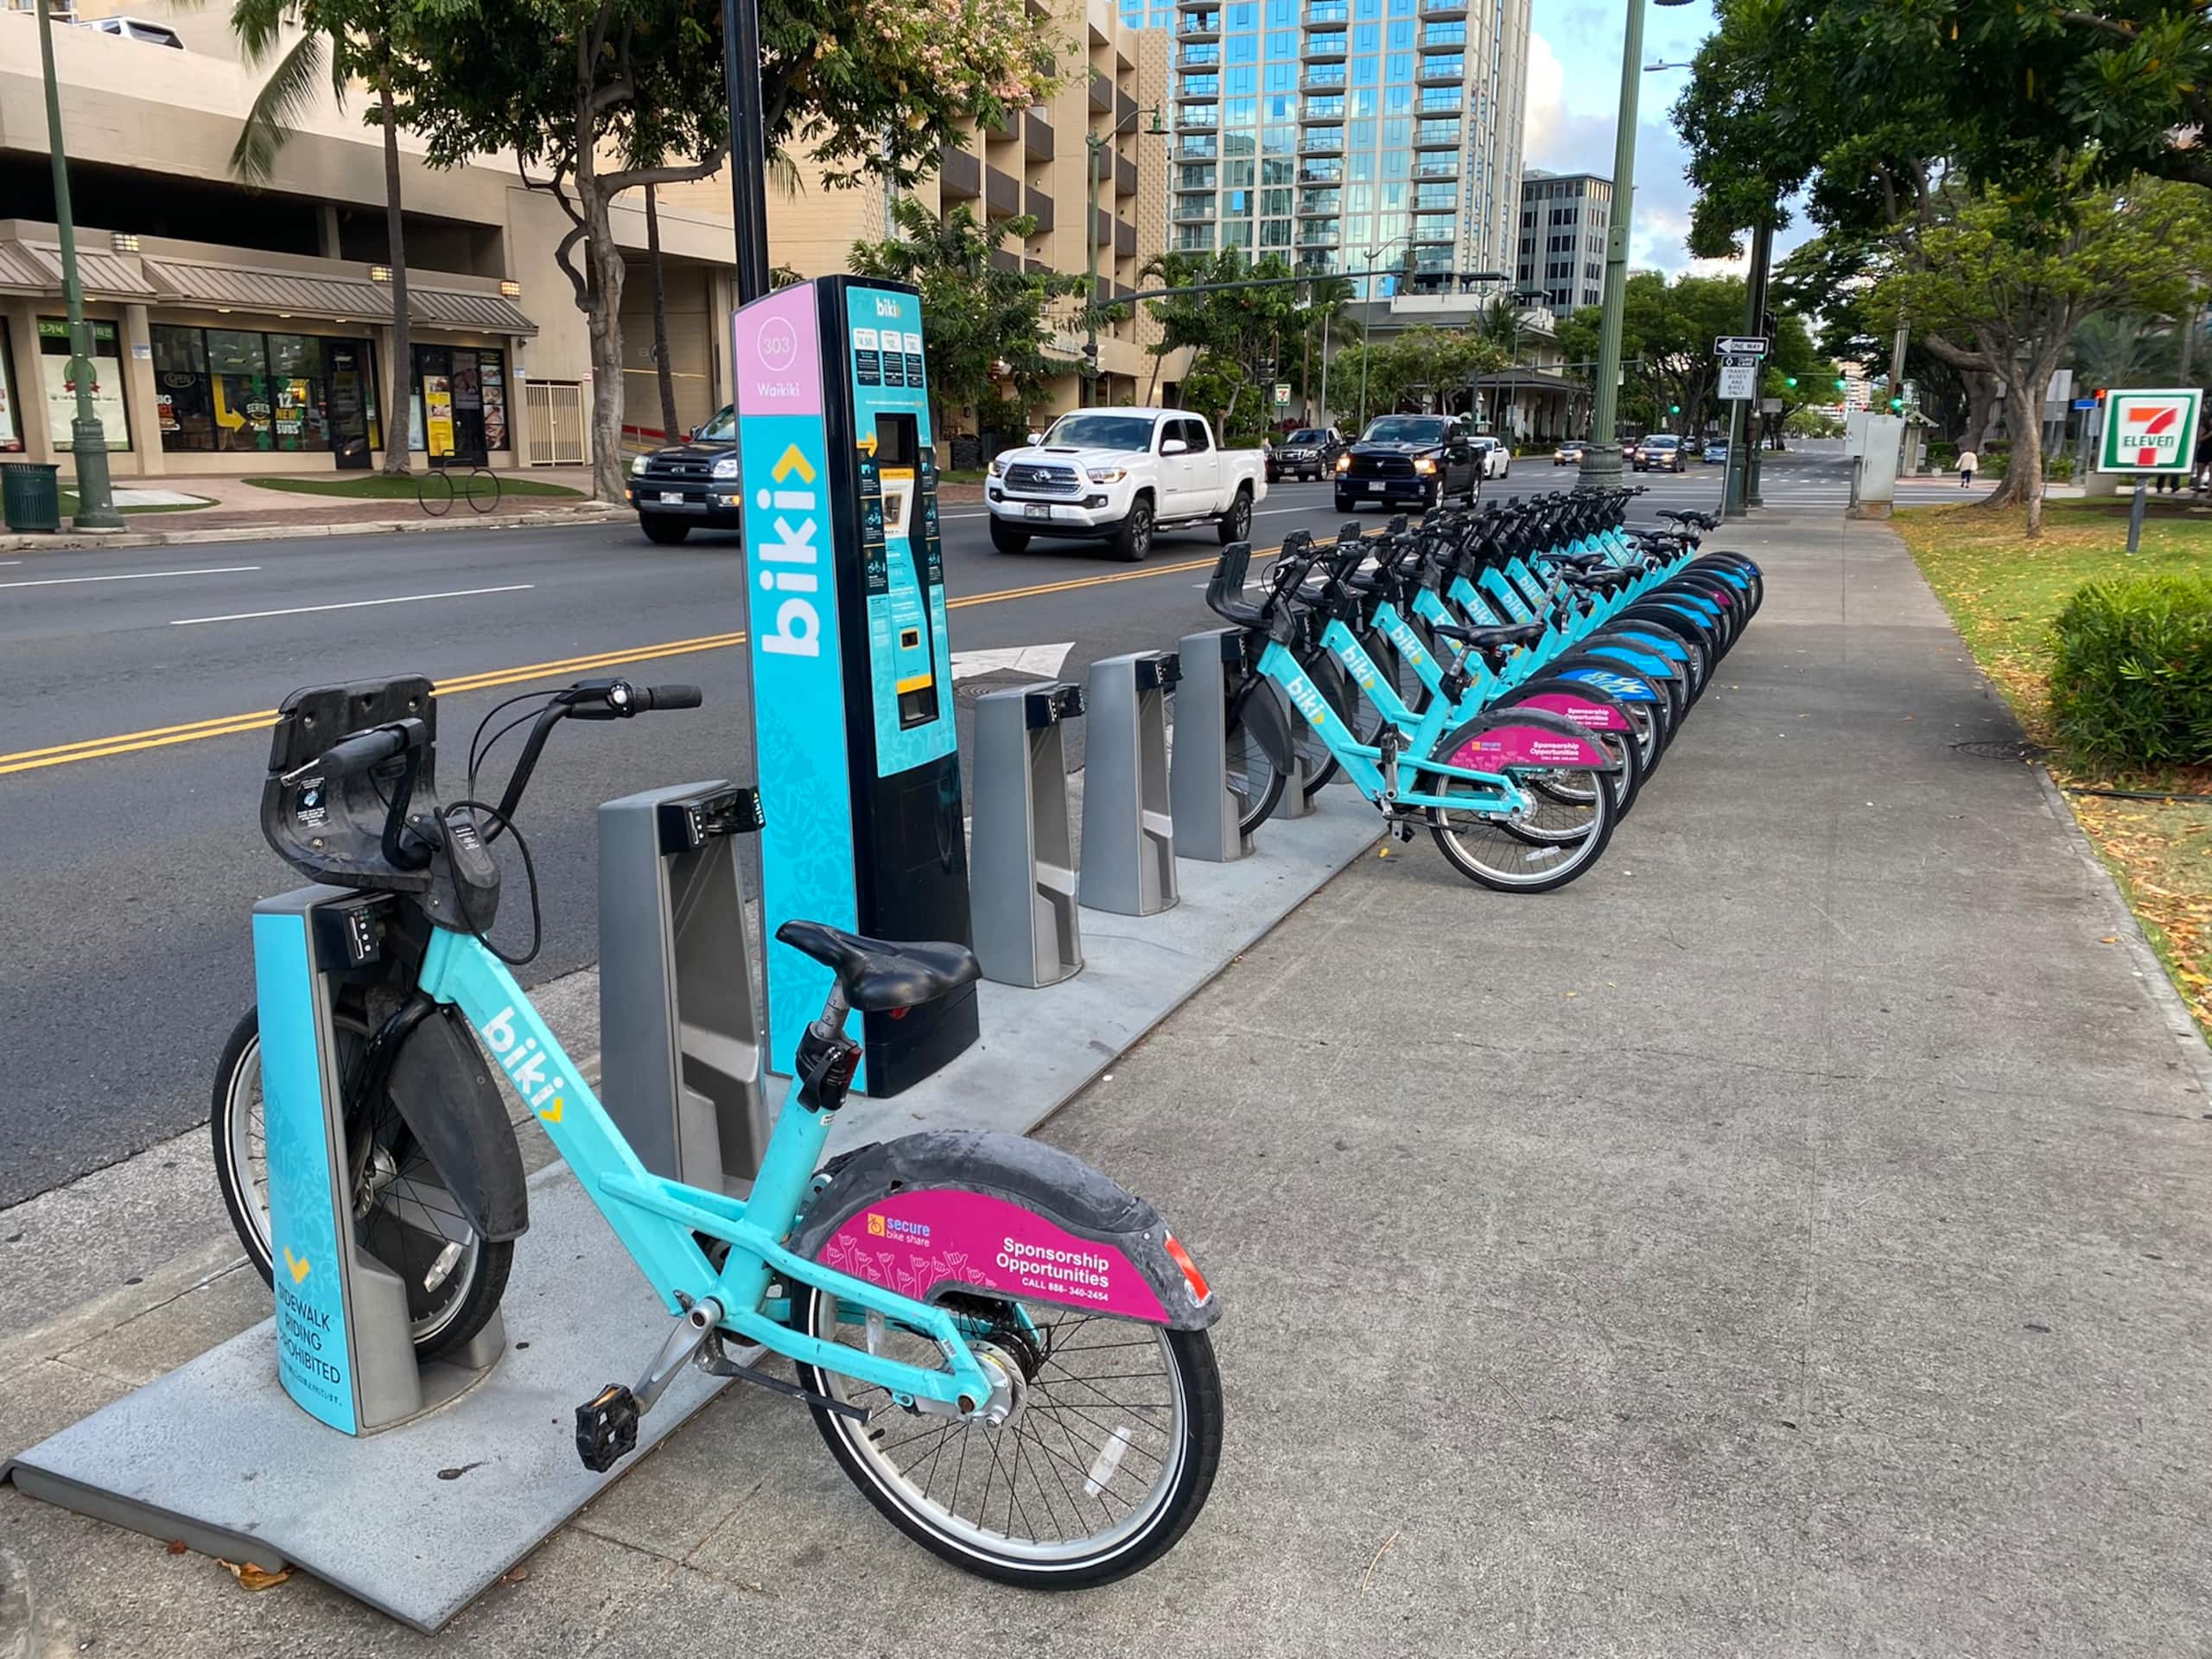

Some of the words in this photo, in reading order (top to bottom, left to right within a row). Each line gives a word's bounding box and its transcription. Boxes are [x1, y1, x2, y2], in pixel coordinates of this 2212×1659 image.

[764, 337, 790, 354] 303
[757, 382, 800, 397] Waikiki
[276, 423, 299, 435] SUBS
[2128, 407, 2178, 465] 7
[757, 488, 820, 658] biki
[1520, 575, 1541, 601] biki
[1391, 625, 1421, 658] biki
[1341, 645, 1374, 683] biki
[1287, 676, 1324, 717] biki
[481, 1006, 564, 1108] biki
[886, 1229, 905, 1242] bike
[906, 1234, 931, 1248] share
[887, 1217, 931, 1237] secure
[996, 1253, 1109, 1288] Opportunities
[1003, 1237, 1109, 1273] Sponsorship
[1022, 1277, 1046, 1289] CALL
[284, 1312, 322, 1351] RIDING
